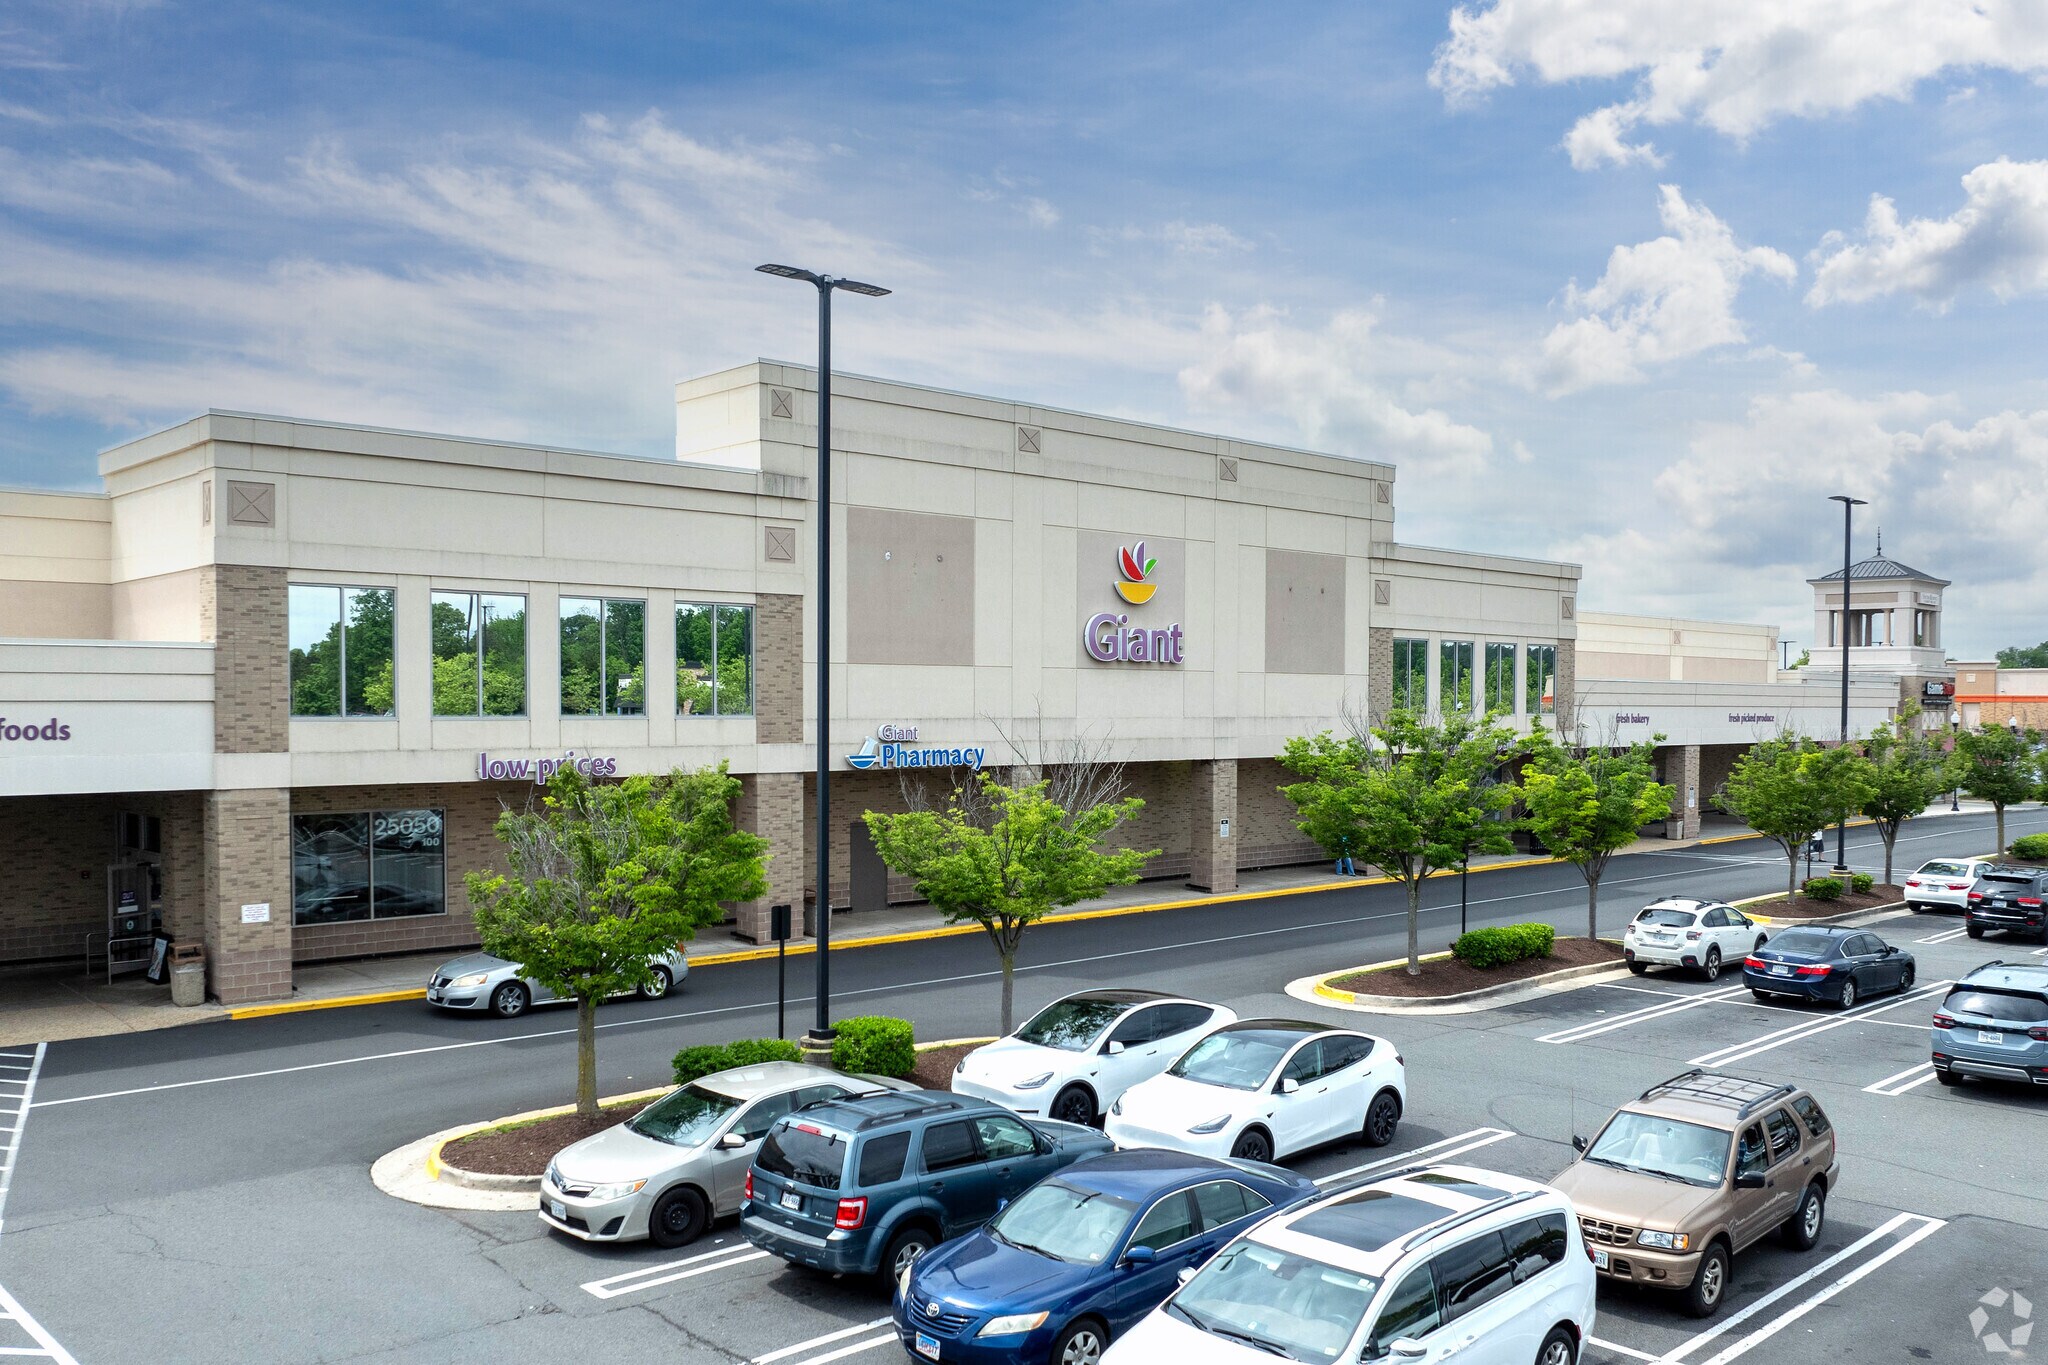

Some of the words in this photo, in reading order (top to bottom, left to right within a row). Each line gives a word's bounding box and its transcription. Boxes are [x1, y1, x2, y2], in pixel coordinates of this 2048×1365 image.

[1084, 612, 1185, 664] Giant
[1615, 712, 1630, 724] fresh
[1630, 712, 1649, 726] bakery
[1728, 712, 1740, 722] fresh
[1740, 712, 1756, 725] picked
[1756, 712, 1775, 725] produce
[878, 724, 920, 741] Giant
[479, 751, 530, 780] low
[881, 743, 986, 771] Pharmacy
[374, 816, 441, 836] 25050
[422, 837, 440, 846] 100
